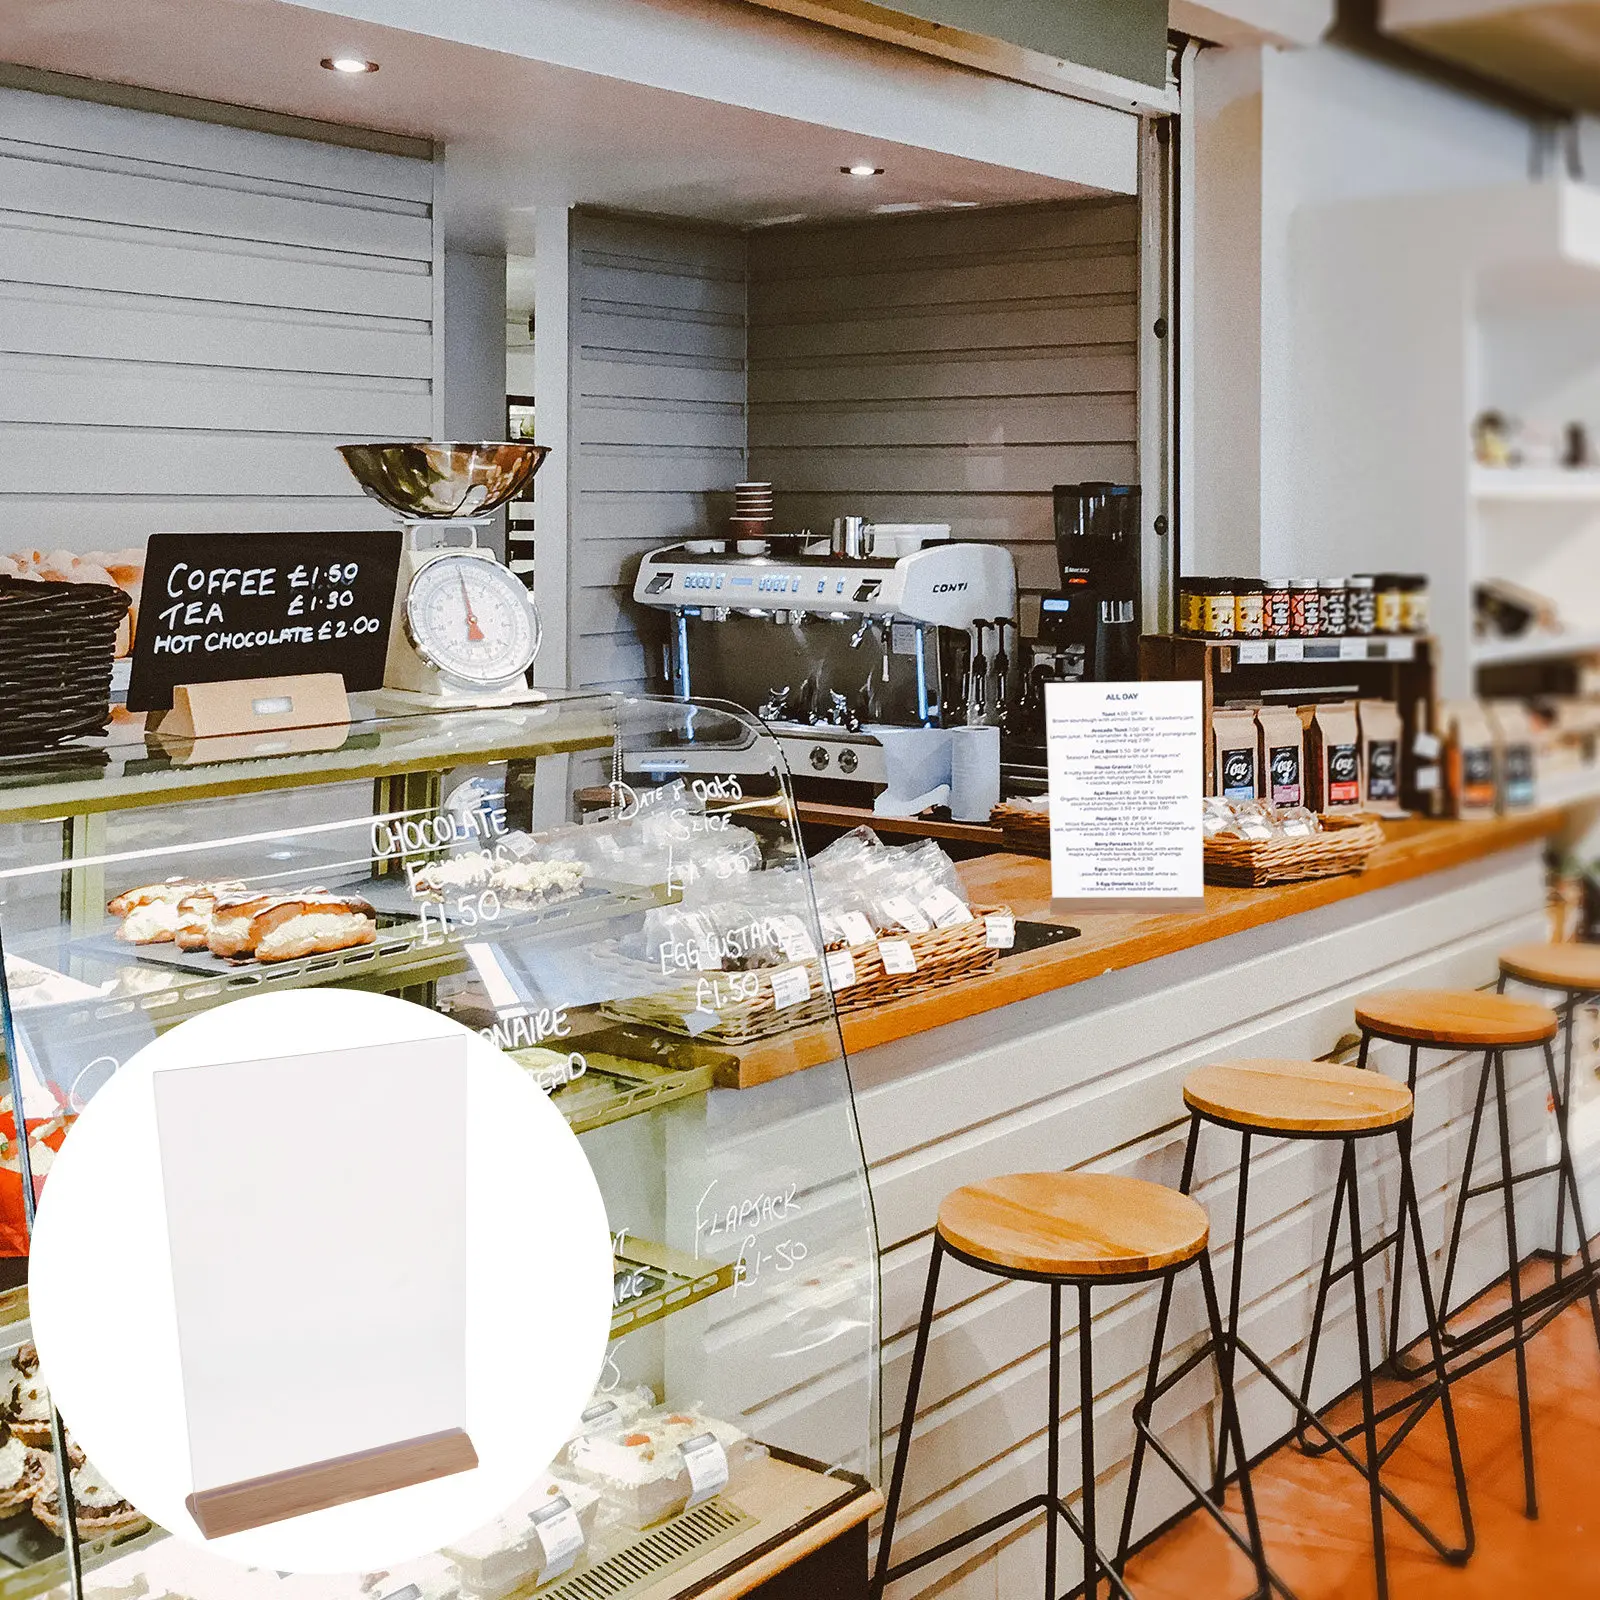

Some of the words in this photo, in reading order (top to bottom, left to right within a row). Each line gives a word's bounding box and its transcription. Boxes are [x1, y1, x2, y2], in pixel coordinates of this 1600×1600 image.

[167, 563, 276, 598] COFFEE
[932, 582, 968, 593] CONTI
[159, 601, 224, 630] TEA
[153, 634, 202, 654] HOT
[204, 626, 313, 652] CHOCOLATE
[609, 781, 663, 820] DATE
[370, 807, 510, 858] CHOCOLATE
[665, 808, 733, 841] SLICE
[419, 889, 502, 945] £1.50
[659, 938, 704, 976] EGG
[695, 971, 760, 1015] £1.50
[695, 1180, 802, 1261] FLAPJACK
